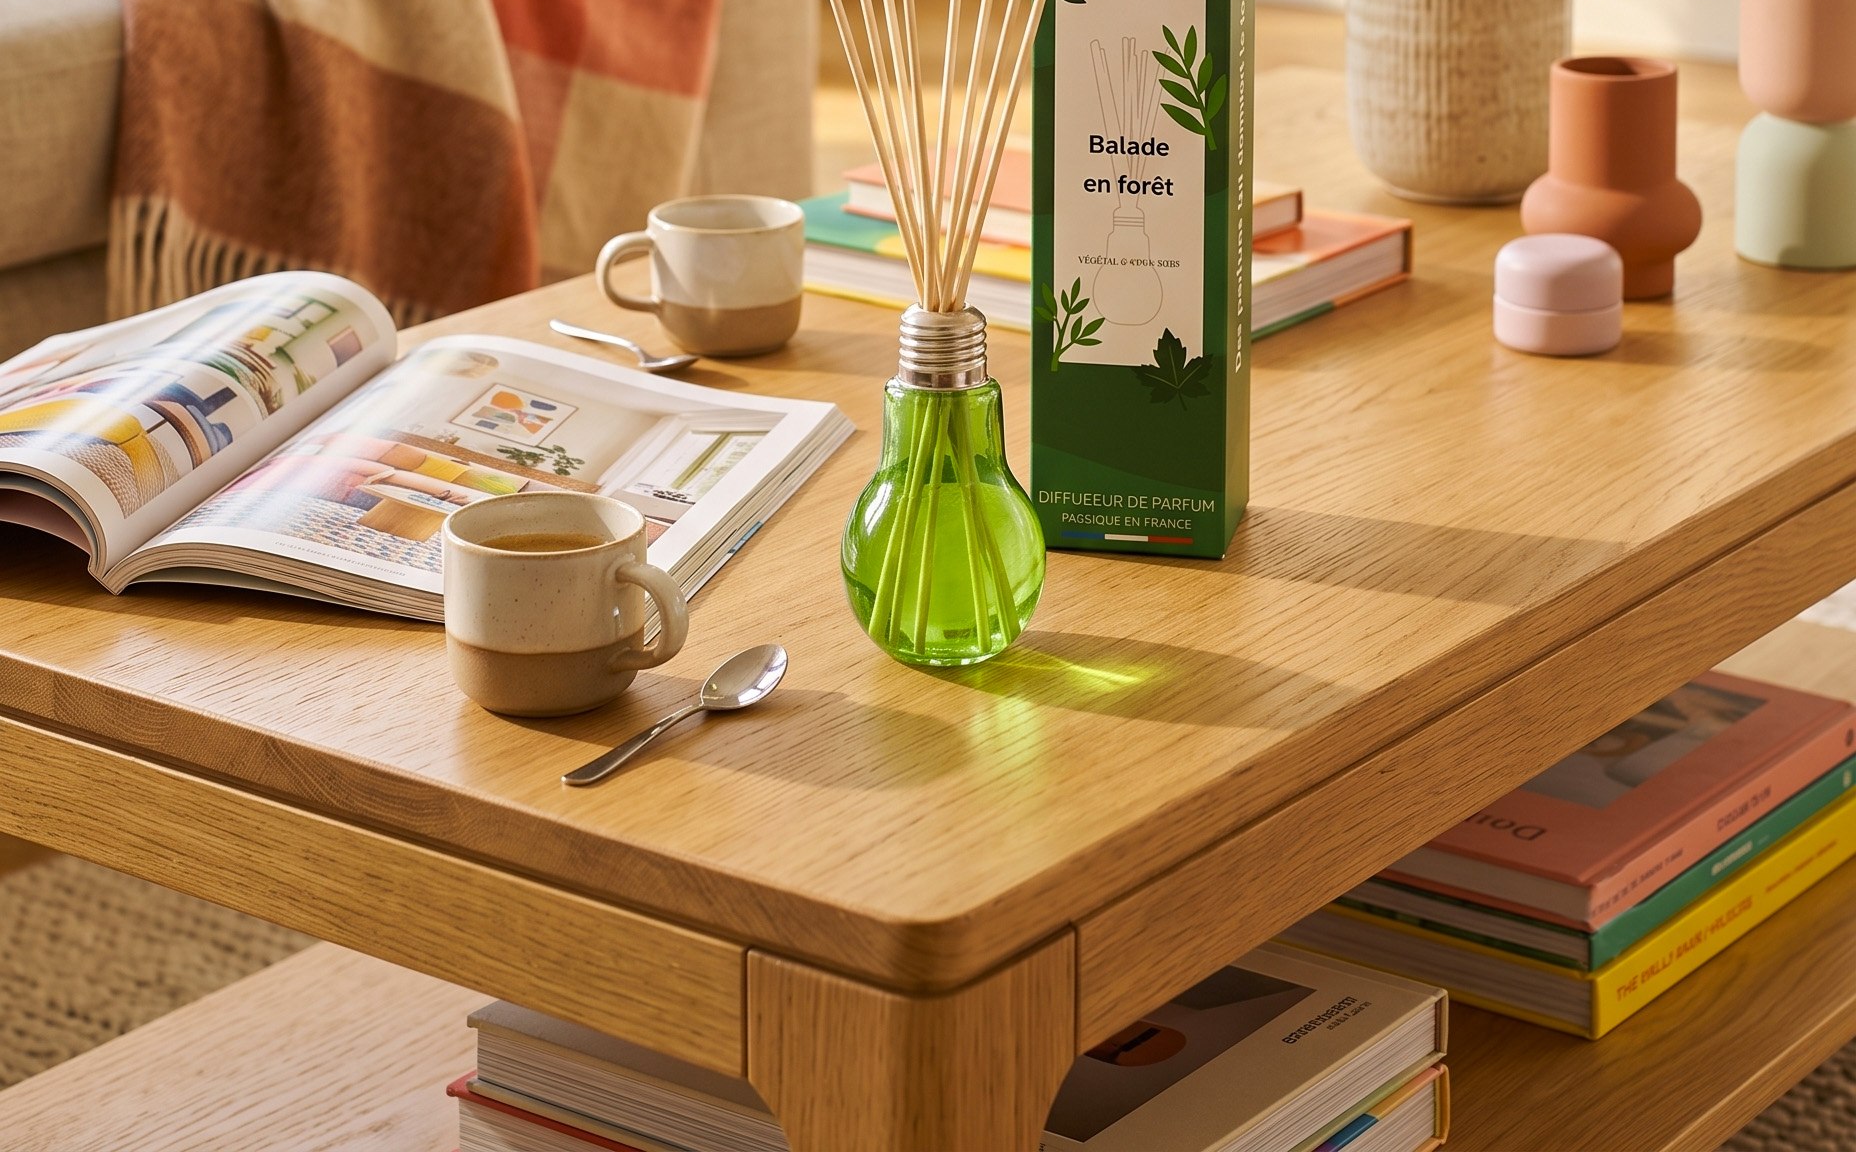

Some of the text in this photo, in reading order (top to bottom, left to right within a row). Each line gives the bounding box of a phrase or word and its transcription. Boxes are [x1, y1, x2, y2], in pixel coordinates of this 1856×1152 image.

[1089, 134, 1170, 156] Balade
[1083, 175, 1174, 196] en forêt
[1038, 490, 1215, 513] DIFFUEEUR DE PARFUM
[1124, 516, 1140, 527] EN
[1144, 517, 1192, 530] FRANCE
